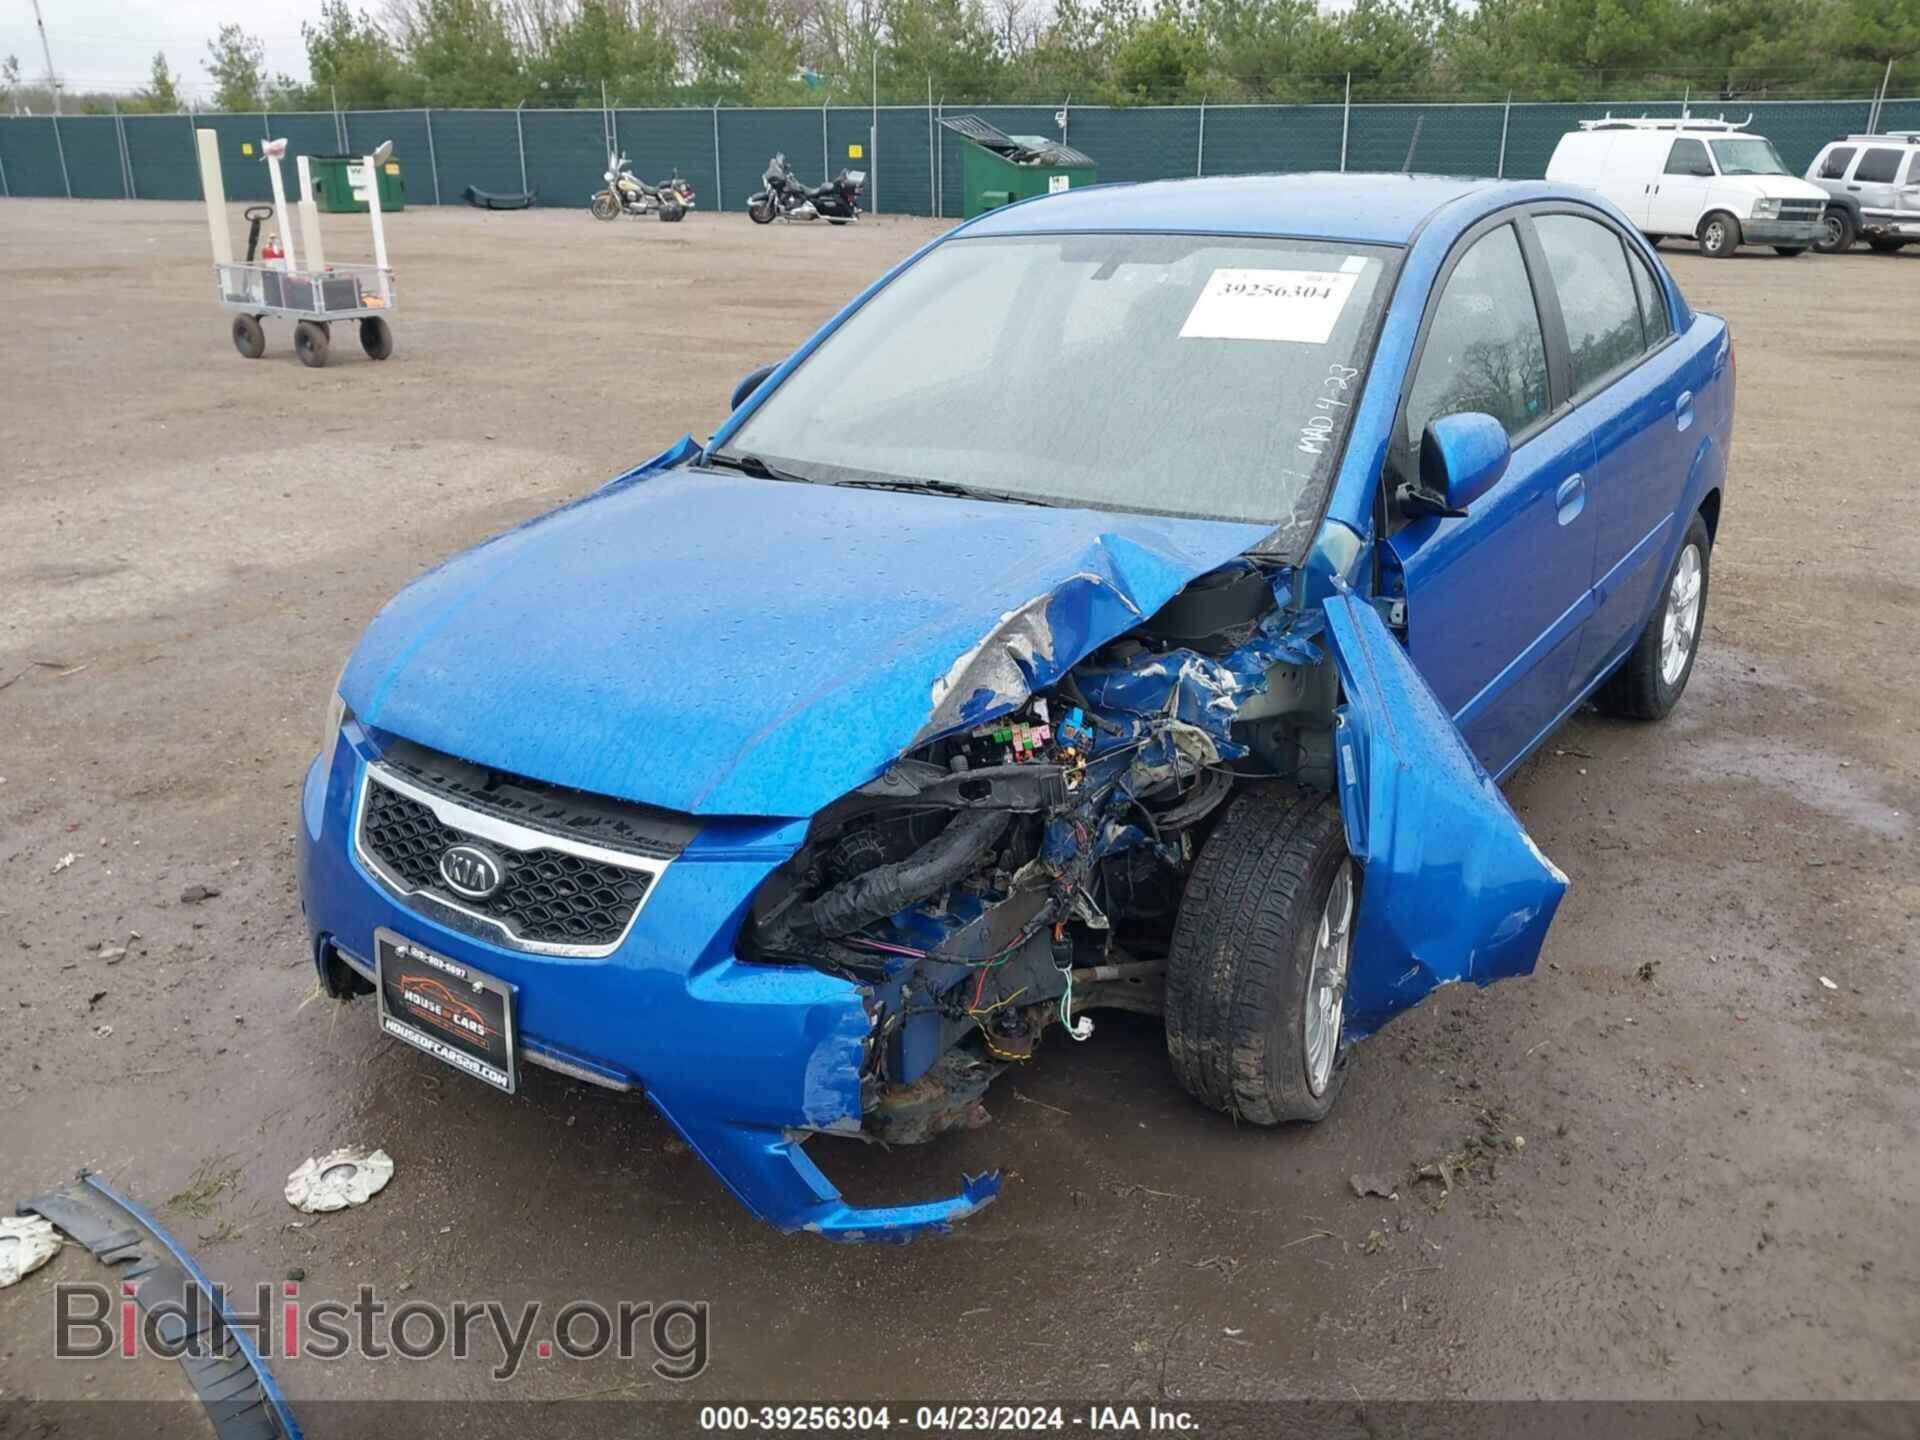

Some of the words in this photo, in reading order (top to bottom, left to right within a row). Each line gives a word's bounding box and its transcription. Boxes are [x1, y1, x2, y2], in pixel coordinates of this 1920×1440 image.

[1217, 283, 1333, 300] 39256304
[448, 852, 487, 891] KIA
[404, 989, 443, 1016] HOUSE
[453, 1013, 486, 1037] CARS
